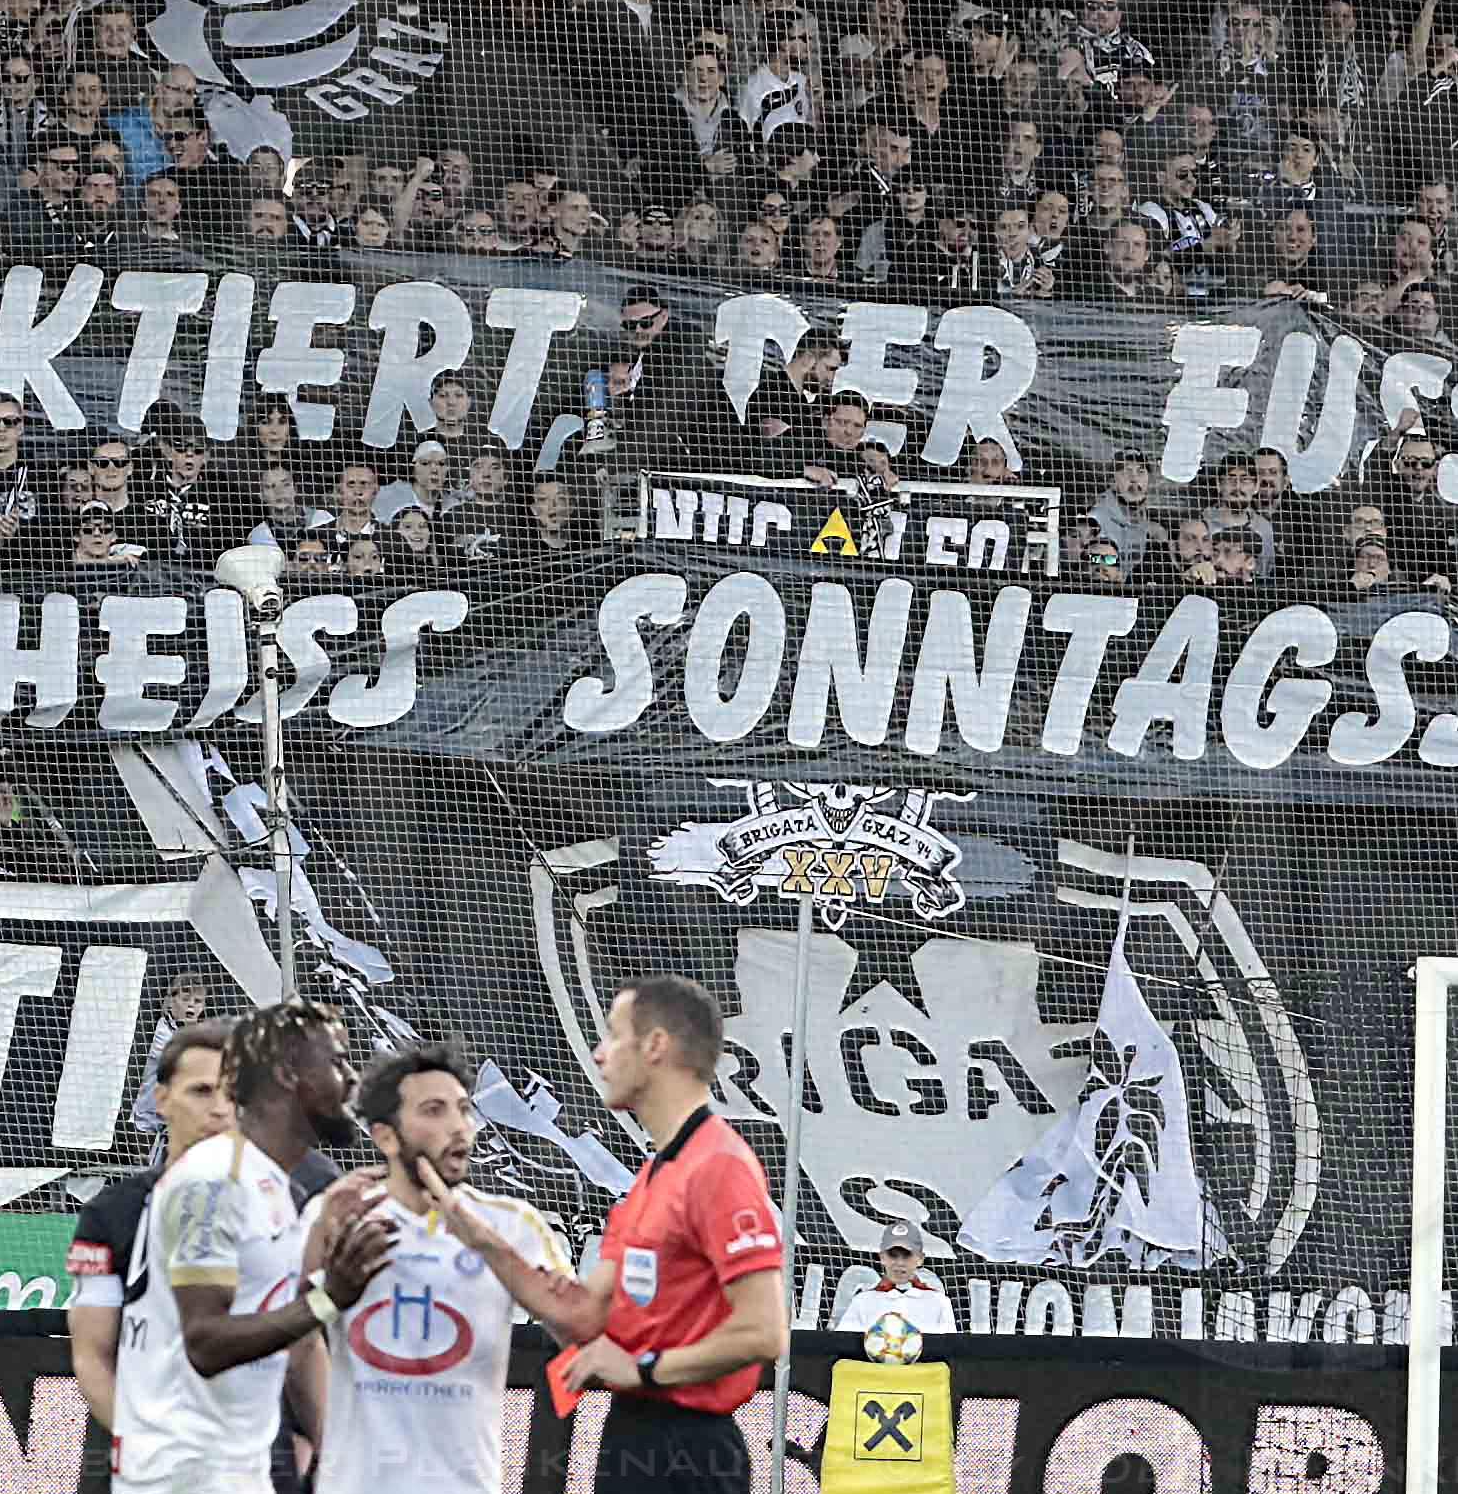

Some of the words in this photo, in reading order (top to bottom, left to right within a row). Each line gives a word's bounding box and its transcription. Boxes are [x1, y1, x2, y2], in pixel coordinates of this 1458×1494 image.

[738, 818, 819, 849] BRIGATA
[862, 818, 911, 847] GRAZ
[781, 849, 894, 899] XXV
